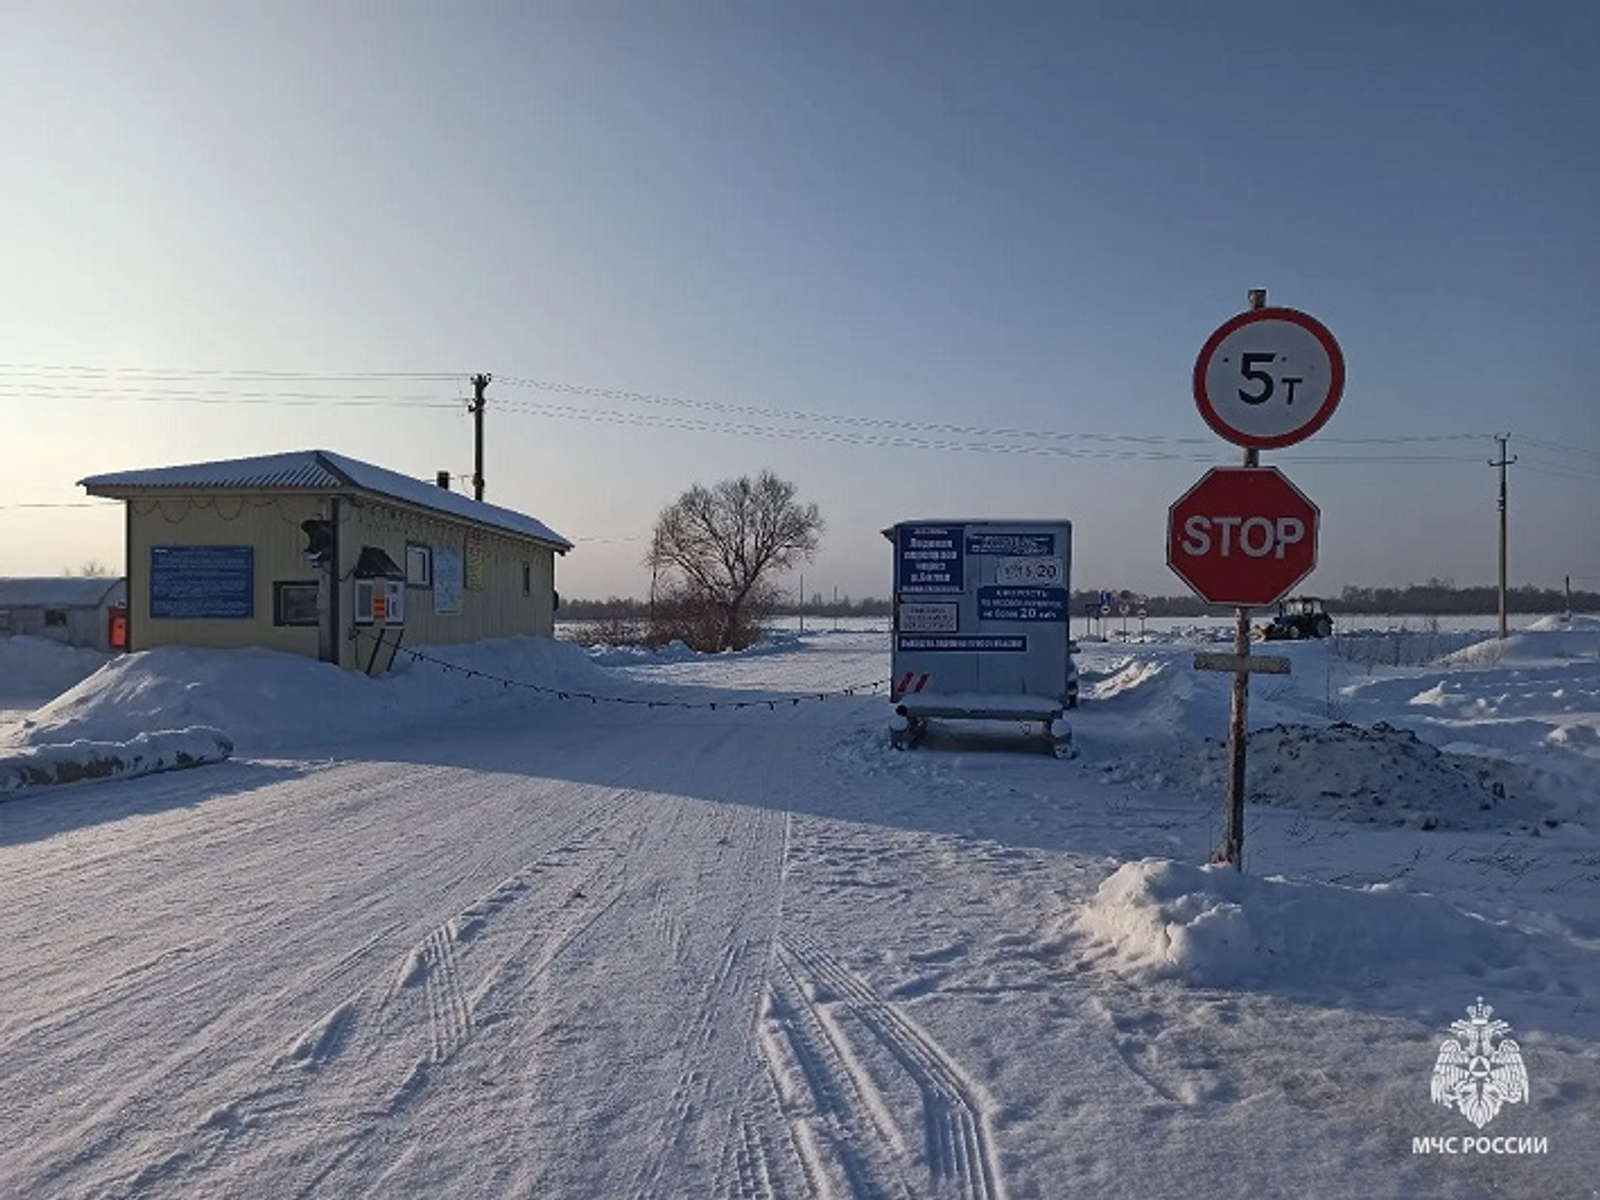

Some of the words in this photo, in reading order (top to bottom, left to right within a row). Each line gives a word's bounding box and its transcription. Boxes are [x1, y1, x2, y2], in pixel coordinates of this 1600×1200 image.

[1182, 515, 1305, 559] STOP
[1037, 564, 1057, 578] 20
[1019, 607, 1037, 618] 20
